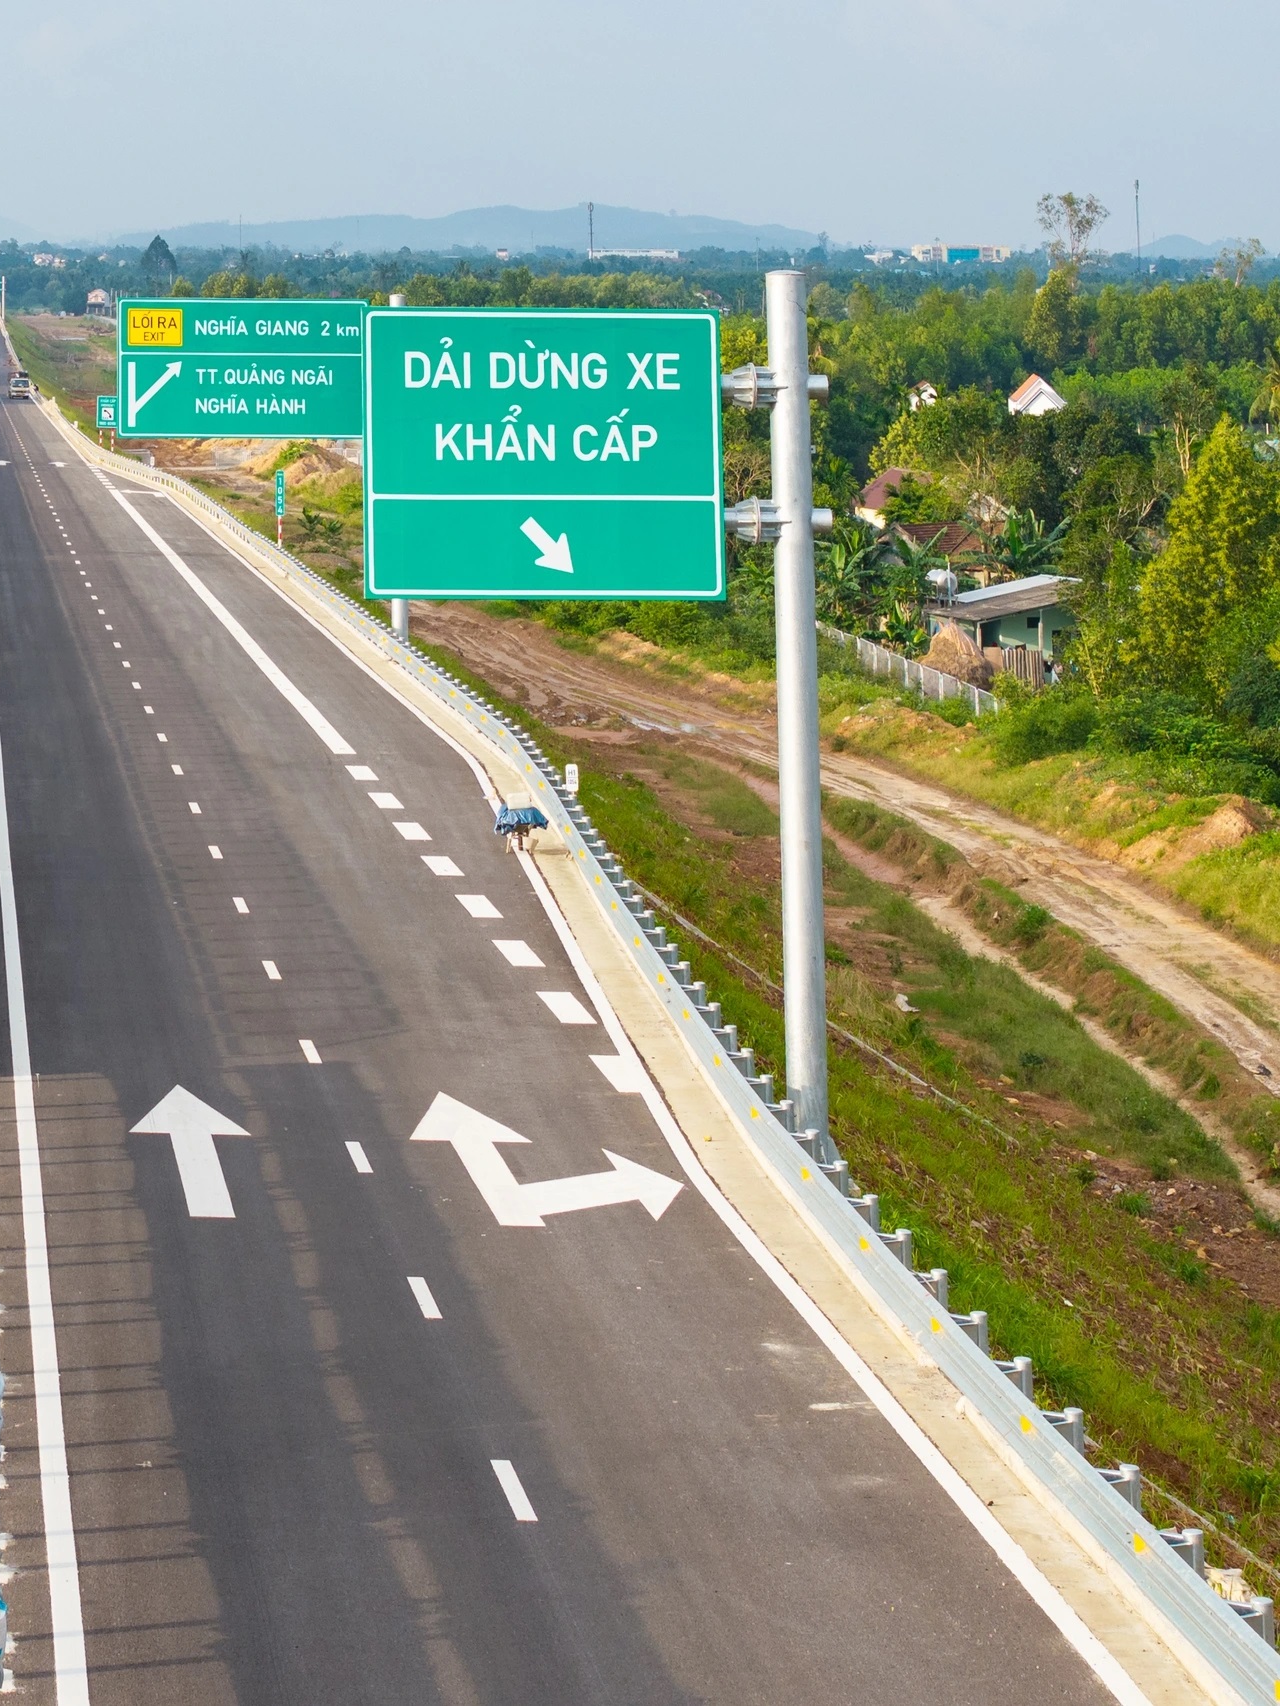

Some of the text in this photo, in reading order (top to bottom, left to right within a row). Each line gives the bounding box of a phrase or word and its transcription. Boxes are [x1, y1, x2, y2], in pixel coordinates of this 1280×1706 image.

[132, 311, 177, 329] LỐI RA
[195, 316, 360, 337] NGHĨA GIANG 2 km
[143, 332, 165, 342] EXIT
[404, 336, 681, 391] DẢI DỪNG XE
[291, 366, 333, 386] NGÃI
[195, 394, 306, 415] NGHĨA HÀNH
[435, 404, 658, 462] KHẨN CẤP
